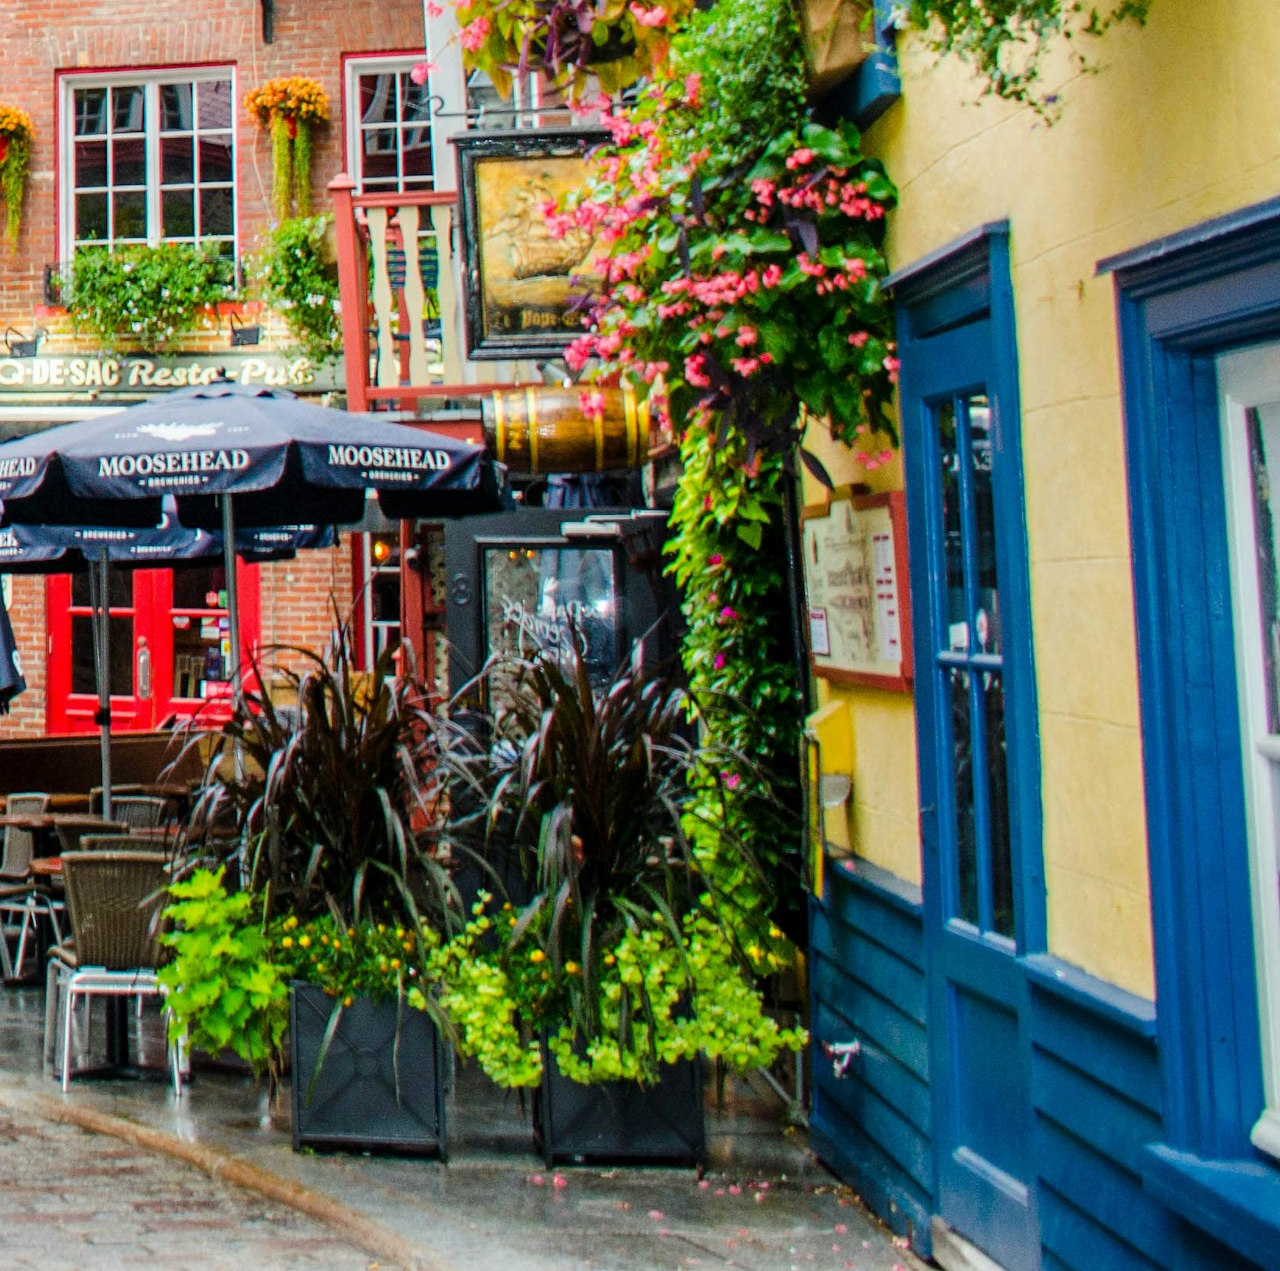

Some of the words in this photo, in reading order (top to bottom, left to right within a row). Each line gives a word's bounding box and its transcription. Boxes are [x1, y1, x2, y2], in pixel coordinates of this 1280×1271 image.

[129, 358, 314, 387] Resto-Pub
[98, 449, 251, 478] MOOSEHEAD
[328, 444, 453, 471] MOOSEHEAD
